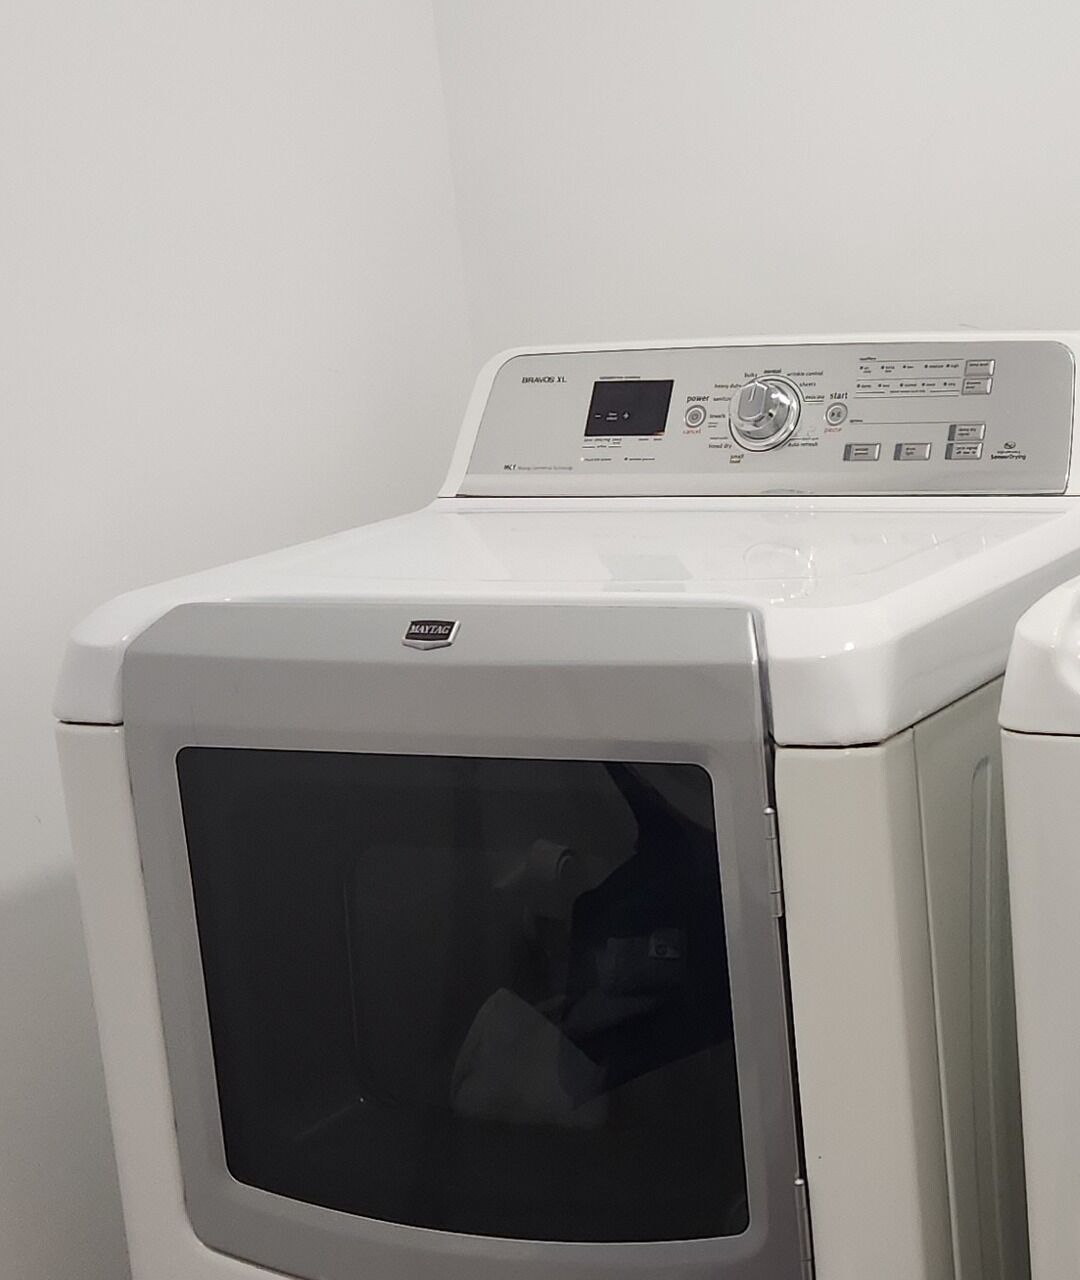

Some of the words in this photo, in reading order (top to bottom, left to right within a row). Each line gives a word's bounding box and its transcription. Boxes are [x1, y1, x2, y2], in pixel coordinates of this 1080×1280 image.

[521, 376, 555, 384] BRAVOS
[686, 395, 710, 403] power
[829, 392, 849, 400] start
[409, 624, 451, 634] MAYTAG
